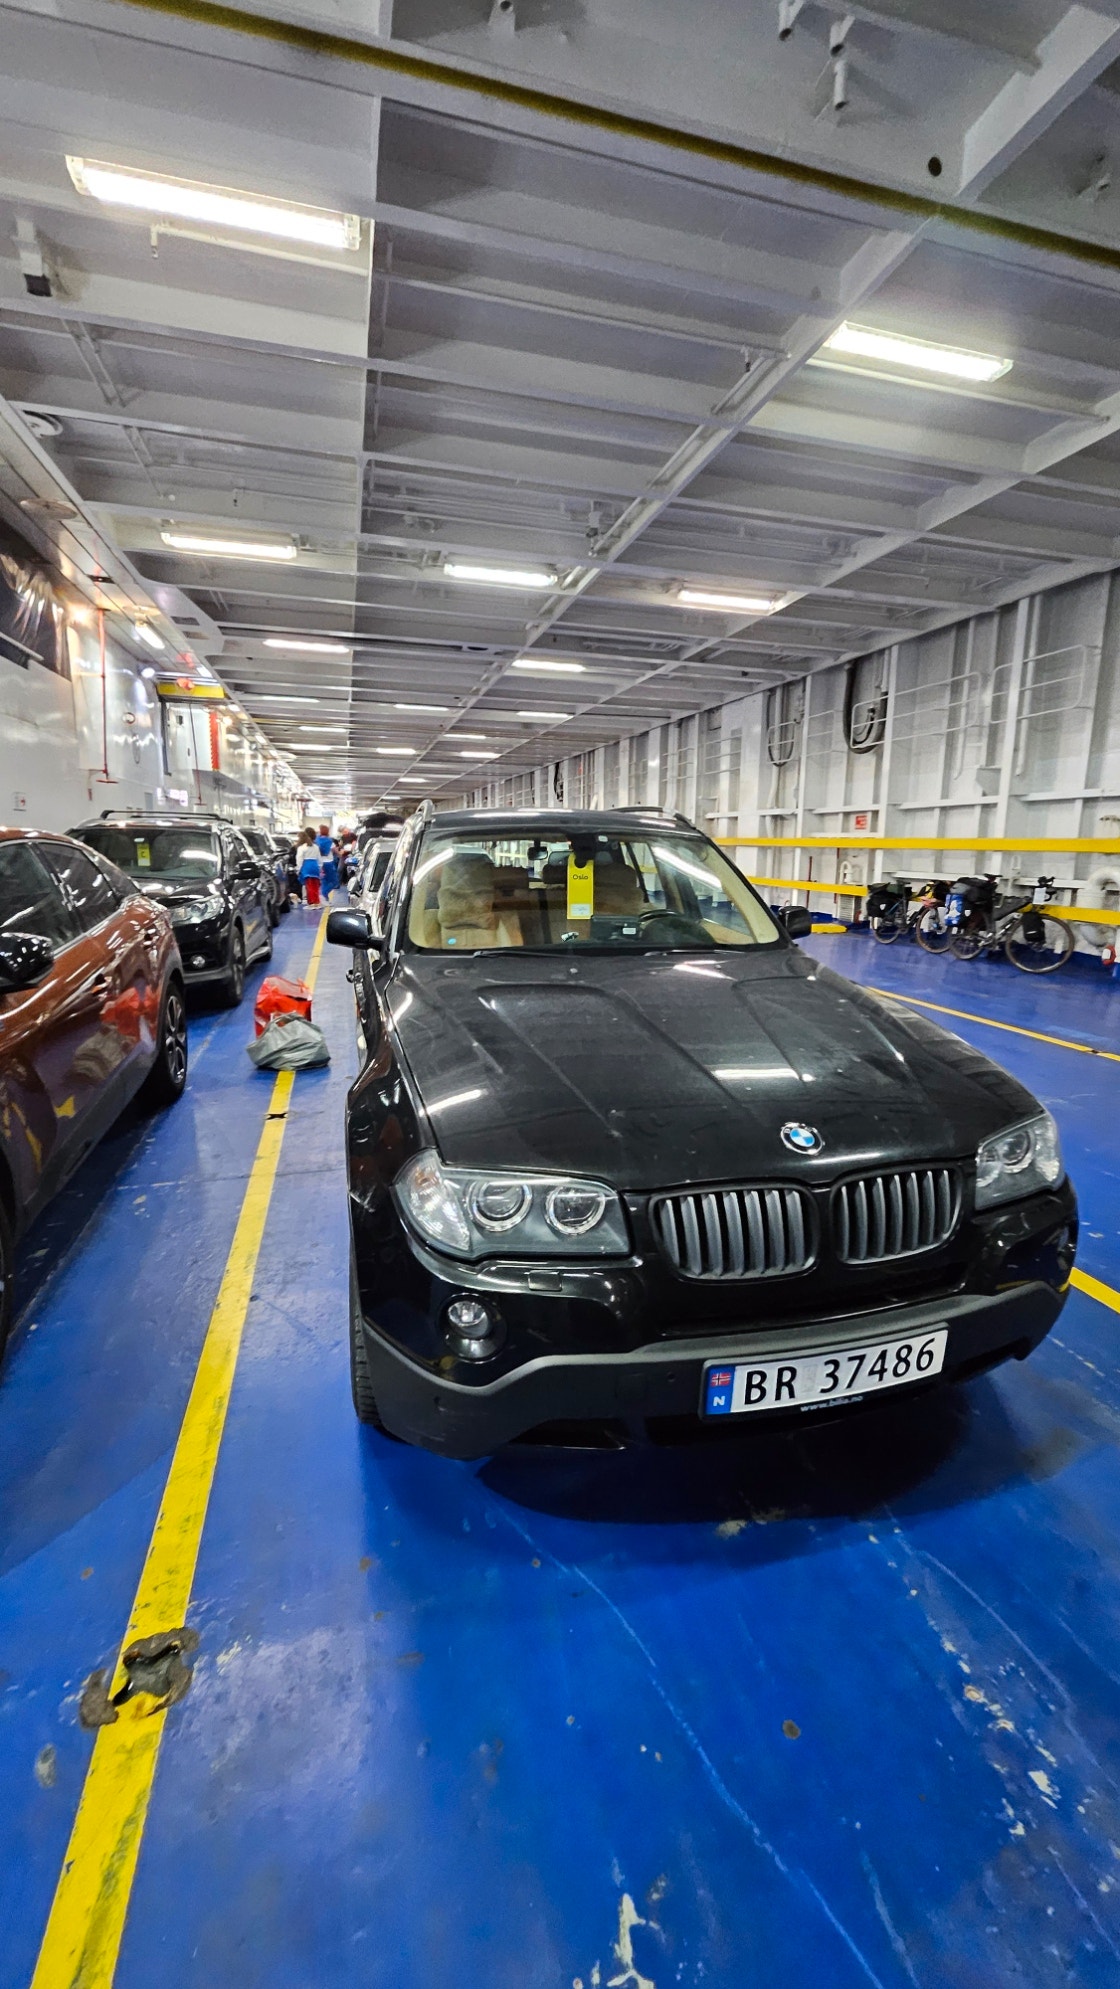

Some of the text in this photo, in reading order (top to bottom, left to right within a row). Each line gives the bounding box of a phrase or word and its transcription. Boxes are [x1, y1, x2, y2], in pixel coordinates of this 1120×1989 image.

[744, 1338, 936, 1405] BR 37486
[713, 1395, 725, 1407] N
